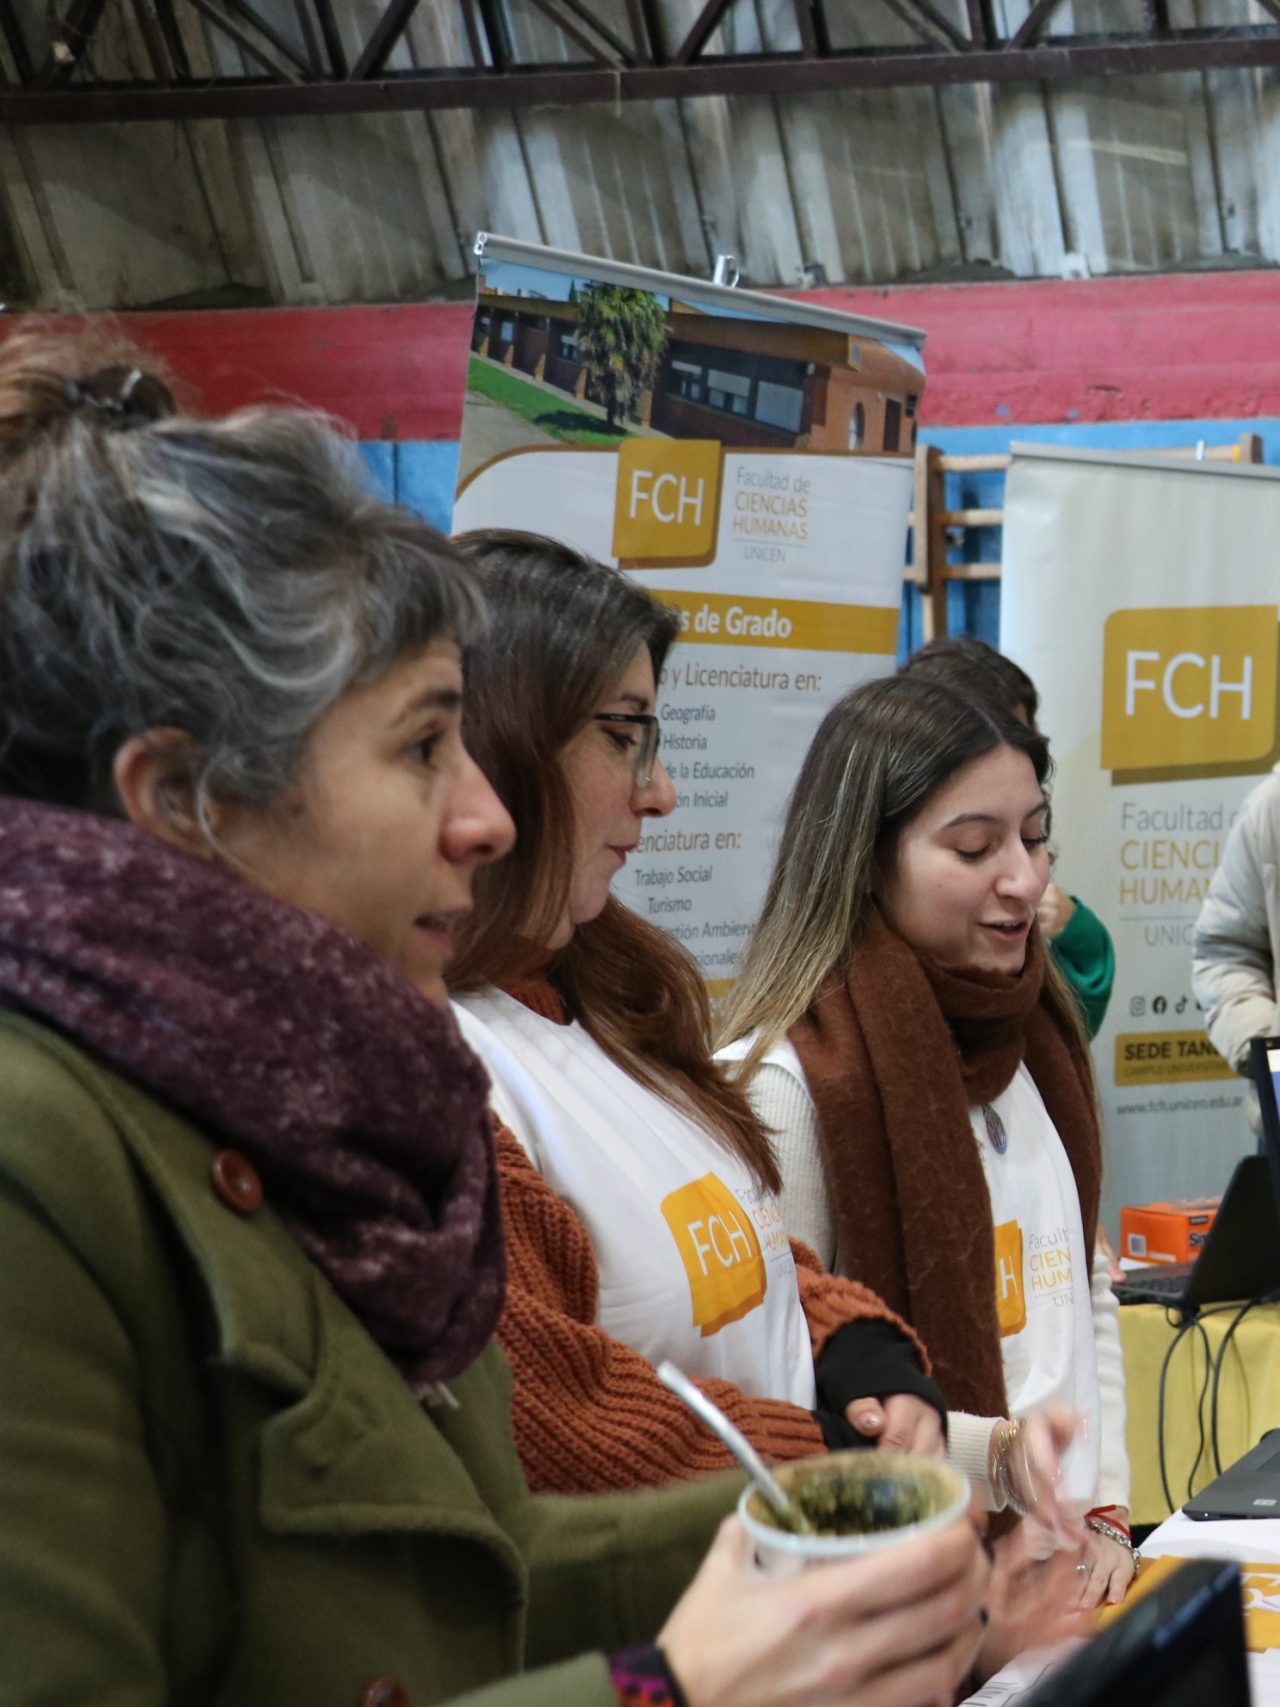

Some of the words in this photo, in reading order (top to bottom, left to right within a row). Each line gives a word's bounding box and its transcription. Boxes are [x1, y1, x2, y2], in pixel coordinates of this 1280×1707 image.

[736, 466, 790, 491] Facultad
[793, 475, 811, 493] de
[628, 469, 705, 526] FCH
[734, 491, 808, 518] CIENCIAS
[732, 515, 808, 540] HUMANAS
[744, 546, 787, 563] UNICEN
[694, 603, 721, 634] de
[725, 605, 793, 639] Grado
[672, 667, 682, 691] y
[685, 661, 790, 691] Licenciatura
[795, 673, 823, 692] en:
[1124, 649, 1254, 722] FCH
[662, 733, 708, 751] Historia
[679, 762, 689, 779] la
[692, 761, 755, 780] Educación
[693, 791, 728, 809] Inicial
[1121, 802, 1224, 832] Facultad
[630, 828, 710, 854] enciatura
[715, 831, 742, 850] en:
[1119, 838, 1220, 871] CIENCI
[635, 868, 674, 889] Trabajo
[676, 864, 713, 884] Social
[647, 896, 693, 915] Turismo
[1144, 923, 1197, 946] UNIC
[1124, 1041, 1171, 1061] SEDE
[1177, 1039, 1219, 1057] TAN
[687, 1209, 753, 1277] FCH
[1029, 1227, 1071, 1250] Facult
[1030, 1247, 1072, 1272] CIEN
[1030, 1267, 1072, 1292] HUM
